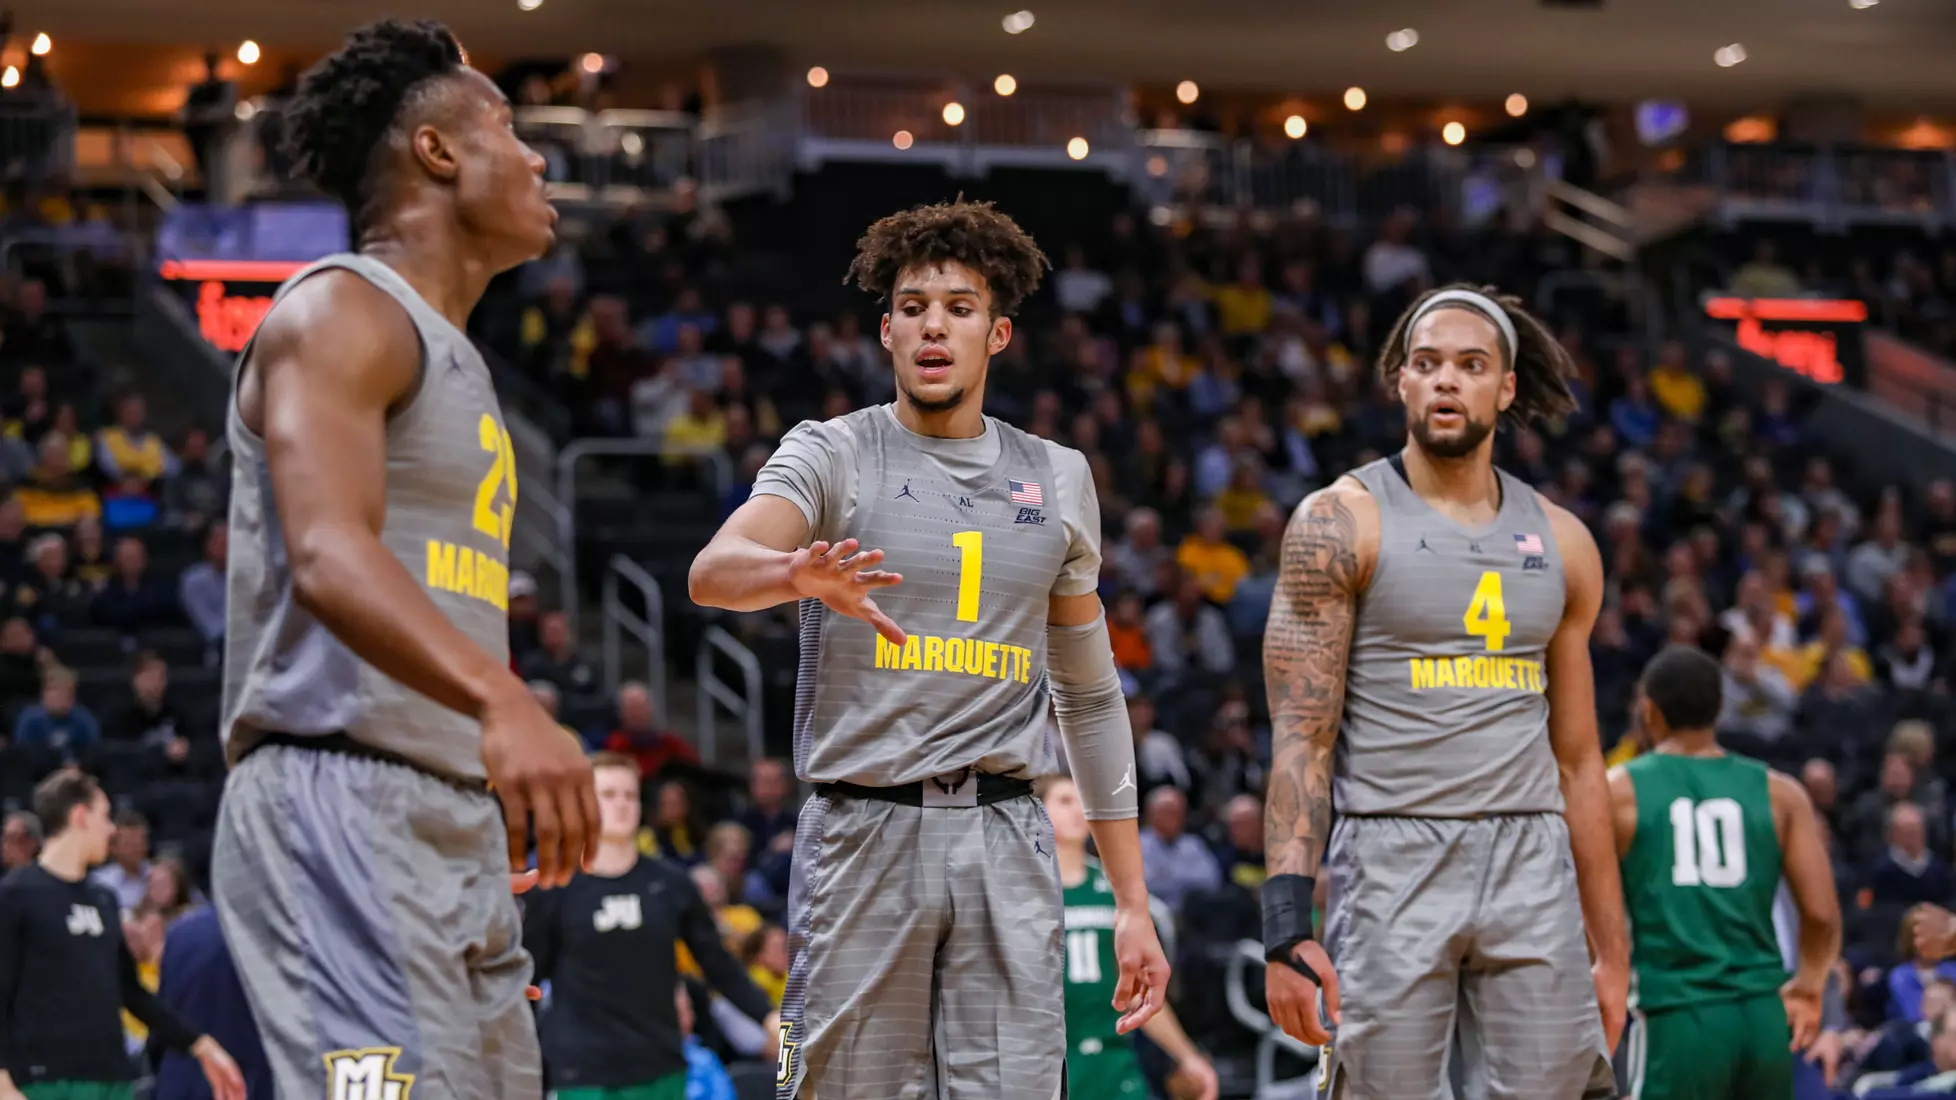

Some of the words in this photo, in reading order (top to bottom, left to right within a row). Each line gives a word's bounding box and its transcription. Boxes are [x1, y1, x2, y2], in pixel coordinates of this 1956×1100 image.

[960, 497, 974, 507] AL
[1015, 515, 1047, 524] EAST
[1019, 507, 1041, 516] BIG
[953, 531, 982, 622] 1
[1463, 571, 1511, 652] 4
[875, 633, 1032, 684] MARQUETTE
[1410, 656, 1544, 694] MARQUETTE
[1670, 796, 1748, 888] 10
